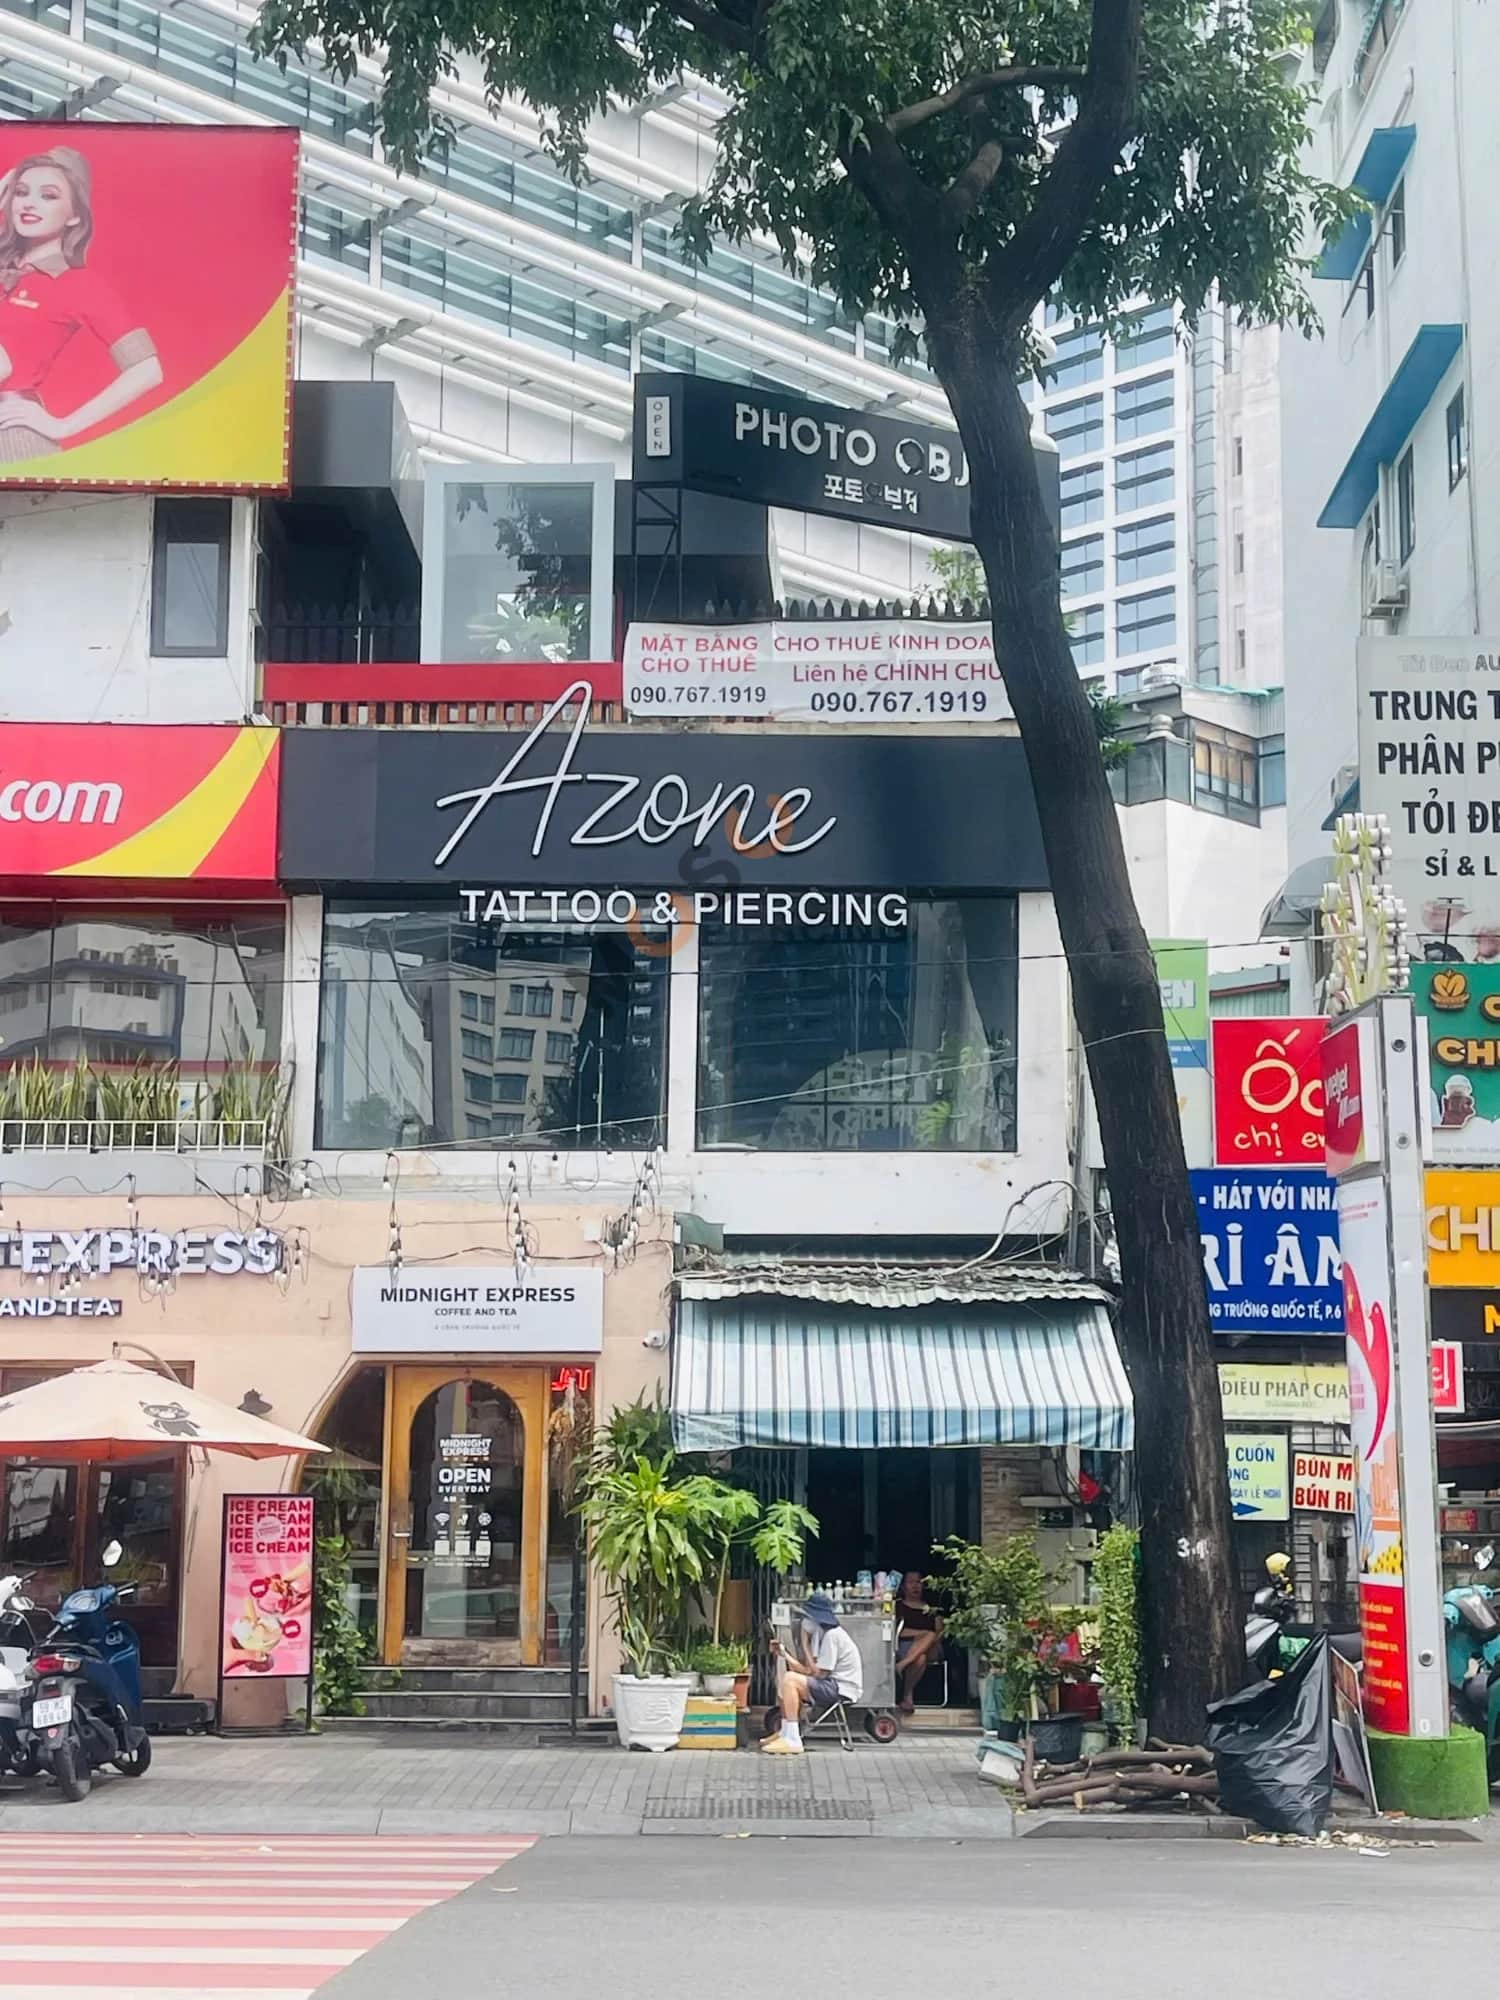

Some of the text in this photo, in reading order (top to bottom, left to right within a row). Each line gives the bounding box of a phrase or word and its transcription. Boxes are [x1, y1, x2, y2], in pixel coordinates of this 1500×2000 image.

[653, 401, 663, 450] OPEN
[735, 402, 876, 466] PHOTO
[774, 636, 819, 651] CHO
[826, 633, 881, 650] THUÊ
[889, 635, 939, 650] KINH
[641, 653, 757, 672] CHO THUÊ
[793, 664, 836, 682] Liên
[874, 660, 947, 681] CHÍNH
[630, 686, 766, 704] 090.767.1919
[811, 691, 987, 713] 090.767.1919
[1369, 690, 1478, 721] TRUNG
[1378, 733, 1500, 775] PHÂN P
[433, 679, 837, 867] Azone
[1401, 788, 1455, 834] TỎI
[1425, 848, 1448, 876] SỈ
[1457, 856, 1476, 876] &
[460, 889, 908, 926] TATTOO & PIERCING
[1437, 1038, 1500, 1065] CH
[1213, 1178, 1252, 1210] HÁT
[1257, 1178, 1295, 1210] VỚI
[22, 1231, 279, 1275] EXPRESS
[381, 1287, 575, 1303] MIDNIGHT EXPRESS
[0, 1297, 115, 1317] AND TEA
[434, 1308, 517, 1316] COFFEE AND TEA
[1325, 1305, 1342, 1319] P.6
[440, 1438, 492, 1448] MIDNIGHT
[442, 1447, 489, 1456] EXPRESS
[439, 1468, 491, 1484] OPEN
[1296, 1456, 1331, 1478] BÚN
[438, 1485, 491, 1493] EVERYDAY
[1295, 1483, 1330, 1508] BÚN
[230, 1501, 311, 1512] ICE CREAM
[230, 1514, 254, 1525] ICE
[229, 1527, 254, 1539] ICE
[229, 1541, 310, 1553] ICE CREAM
